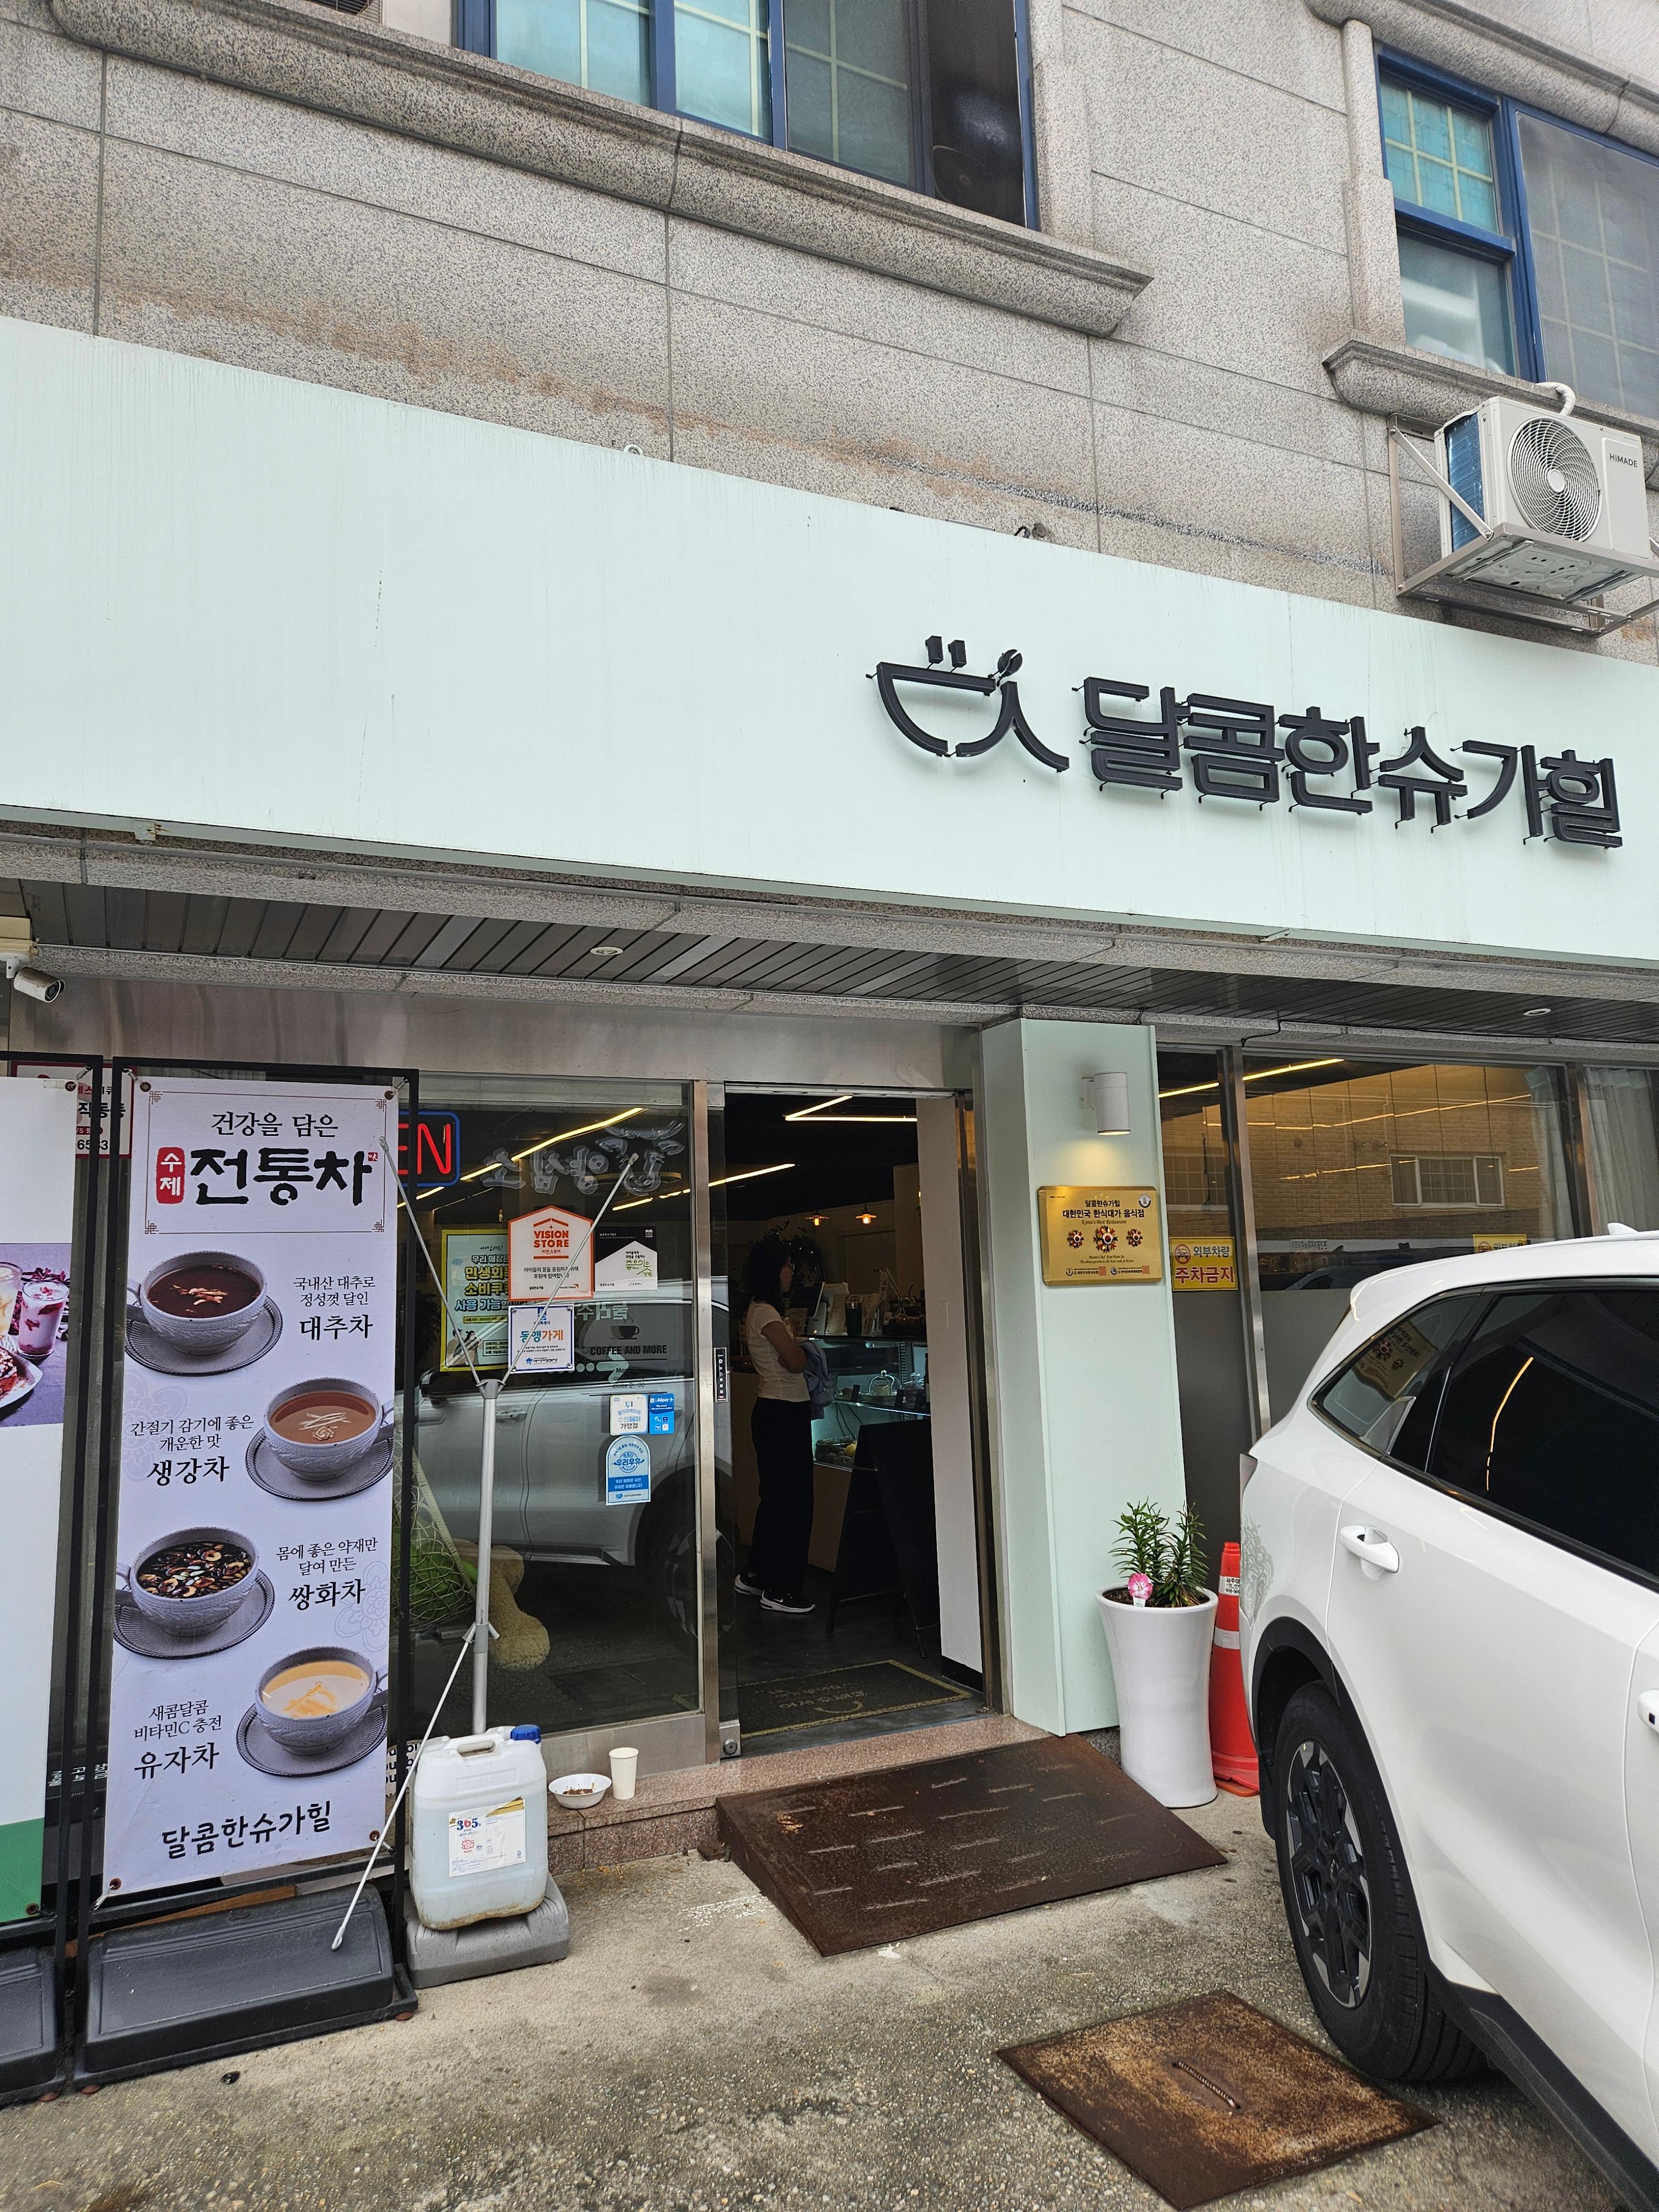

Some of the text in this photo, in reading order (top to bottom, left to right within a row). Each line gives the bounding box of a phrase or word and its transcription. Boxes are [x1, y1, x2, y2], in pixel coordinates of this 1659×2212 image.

[1609, 453, 1638, 467] HIMADE
[1083, 676, 1623, 849] 달콤한슈가힐
[212, 1111, 338, 1138] 건강을 담은
[77, 1139, 108, 1150] 653
[398, 1123, 451, 1175] EN
[159, 1152, 182, 1196] 수제
[190, 1147, 373, 1206] 전통차
[1062, 1209, 1145, 1219] 대한민국 한식대가 음식점
[534, 1230, 569, 1239] VISION
[534, 1239, 569, 1248] STORE
[472, 1254, 488, 1264] 우리
[1193, 1245, 1230, 1258] 외부차량
[293, 1276, 376, 1291] 국내산 대추로
[1175, 1266, 1235, 1284] 주차금지
[300, 1291, 368, 1307] 정성껏 달인
[455, 1298, 478, 1311] 사용
[299, 1314, 373, 1341] 대추차
[520, 1329, 564, 1343] 동행가게
[591, 1344, 667, 1355] COFFEE AND MORE
[130, 1415, 254, 1436] 간절기 감기에 좋은
[160, 1433, 222, 1452] 개운한 맛
[147, 1455, 229, 1486] 생강차
[614, 1458, 645, 1466] 우리우유
[276, 1537, 378, 1561] 몸에 좋은 약재만
[299, 1557, 357, 1576] 달여 만든
[288, 1578, 366, 1611] 쌍화차
[148, 1699, 209, 1721] 새콤달콤
[134, 1715, 222, 1742] 비타민C 충전
[134, 1742, 220, 1780] 유자차
[161, 1800, 331, 1859] 달콤한슈가힐
